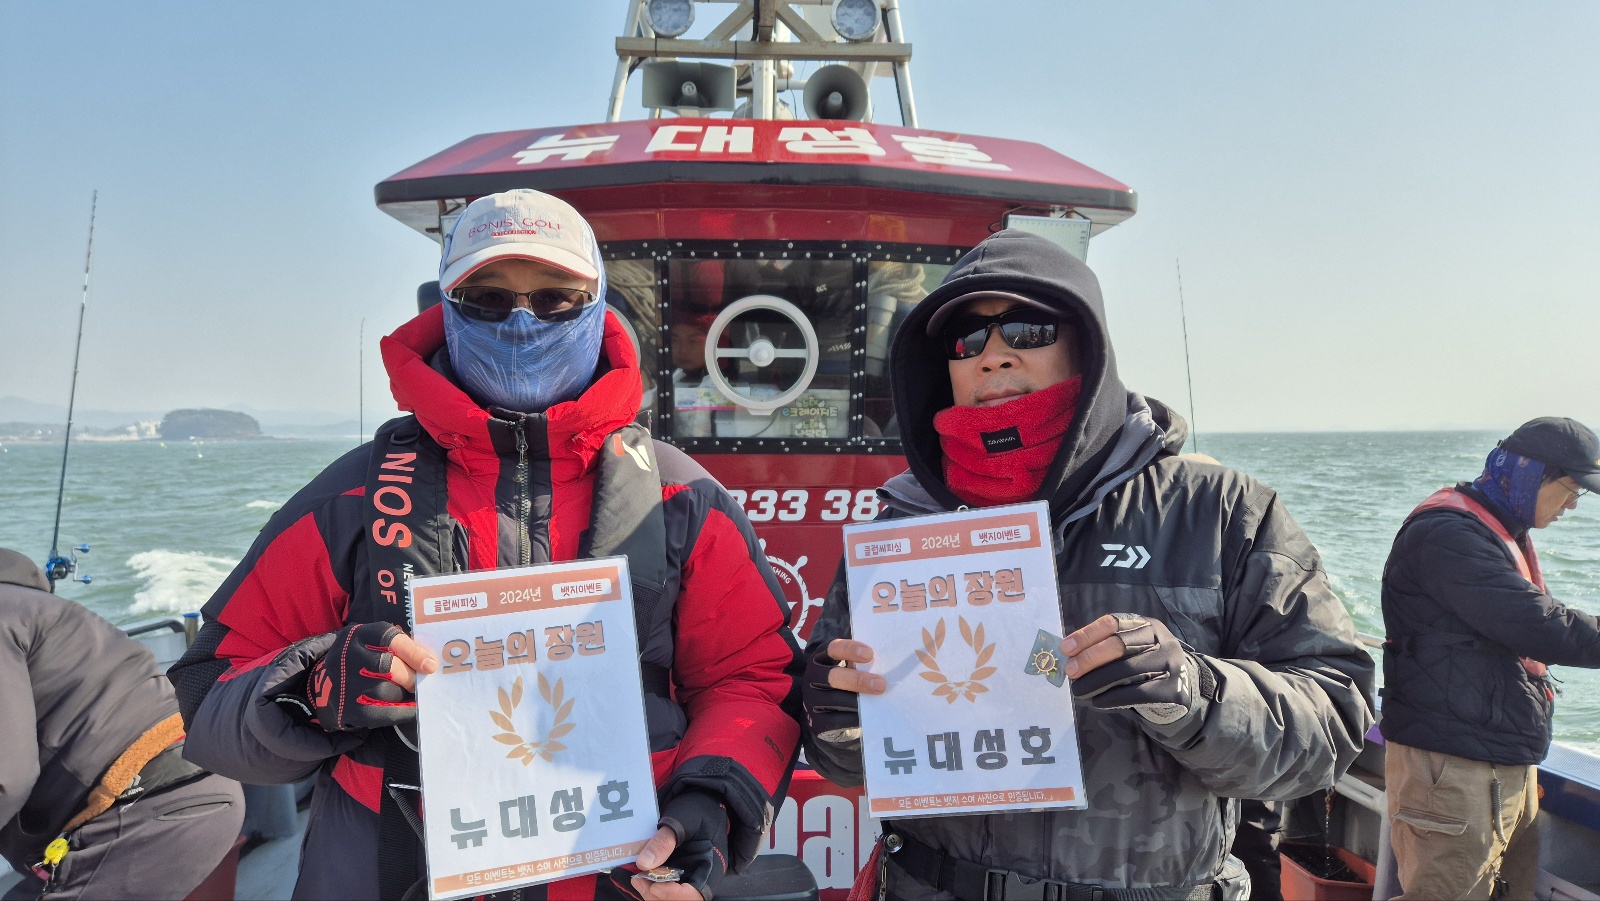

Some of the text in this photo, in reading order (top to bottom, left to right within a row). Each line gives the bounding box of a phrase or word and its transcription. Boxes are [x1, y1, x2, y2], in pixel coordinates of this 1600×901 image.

[468, 218, 513, 238] BONIS
[820, 489, 889, 521] 38
[864, 528, 1022, 557] 클럽씨피싱 2024년 뱃지이벤트
[377, 569, 397, 605] OF
[771, 565, 792, 585] SHING
[871, 567, 1026, 614] 오늘의 장원
[433, 582, 603, 613] 클럽씨피싱 2024년 뱃지이벤트
[441, 620, 606, 675] 오늘의 장원
